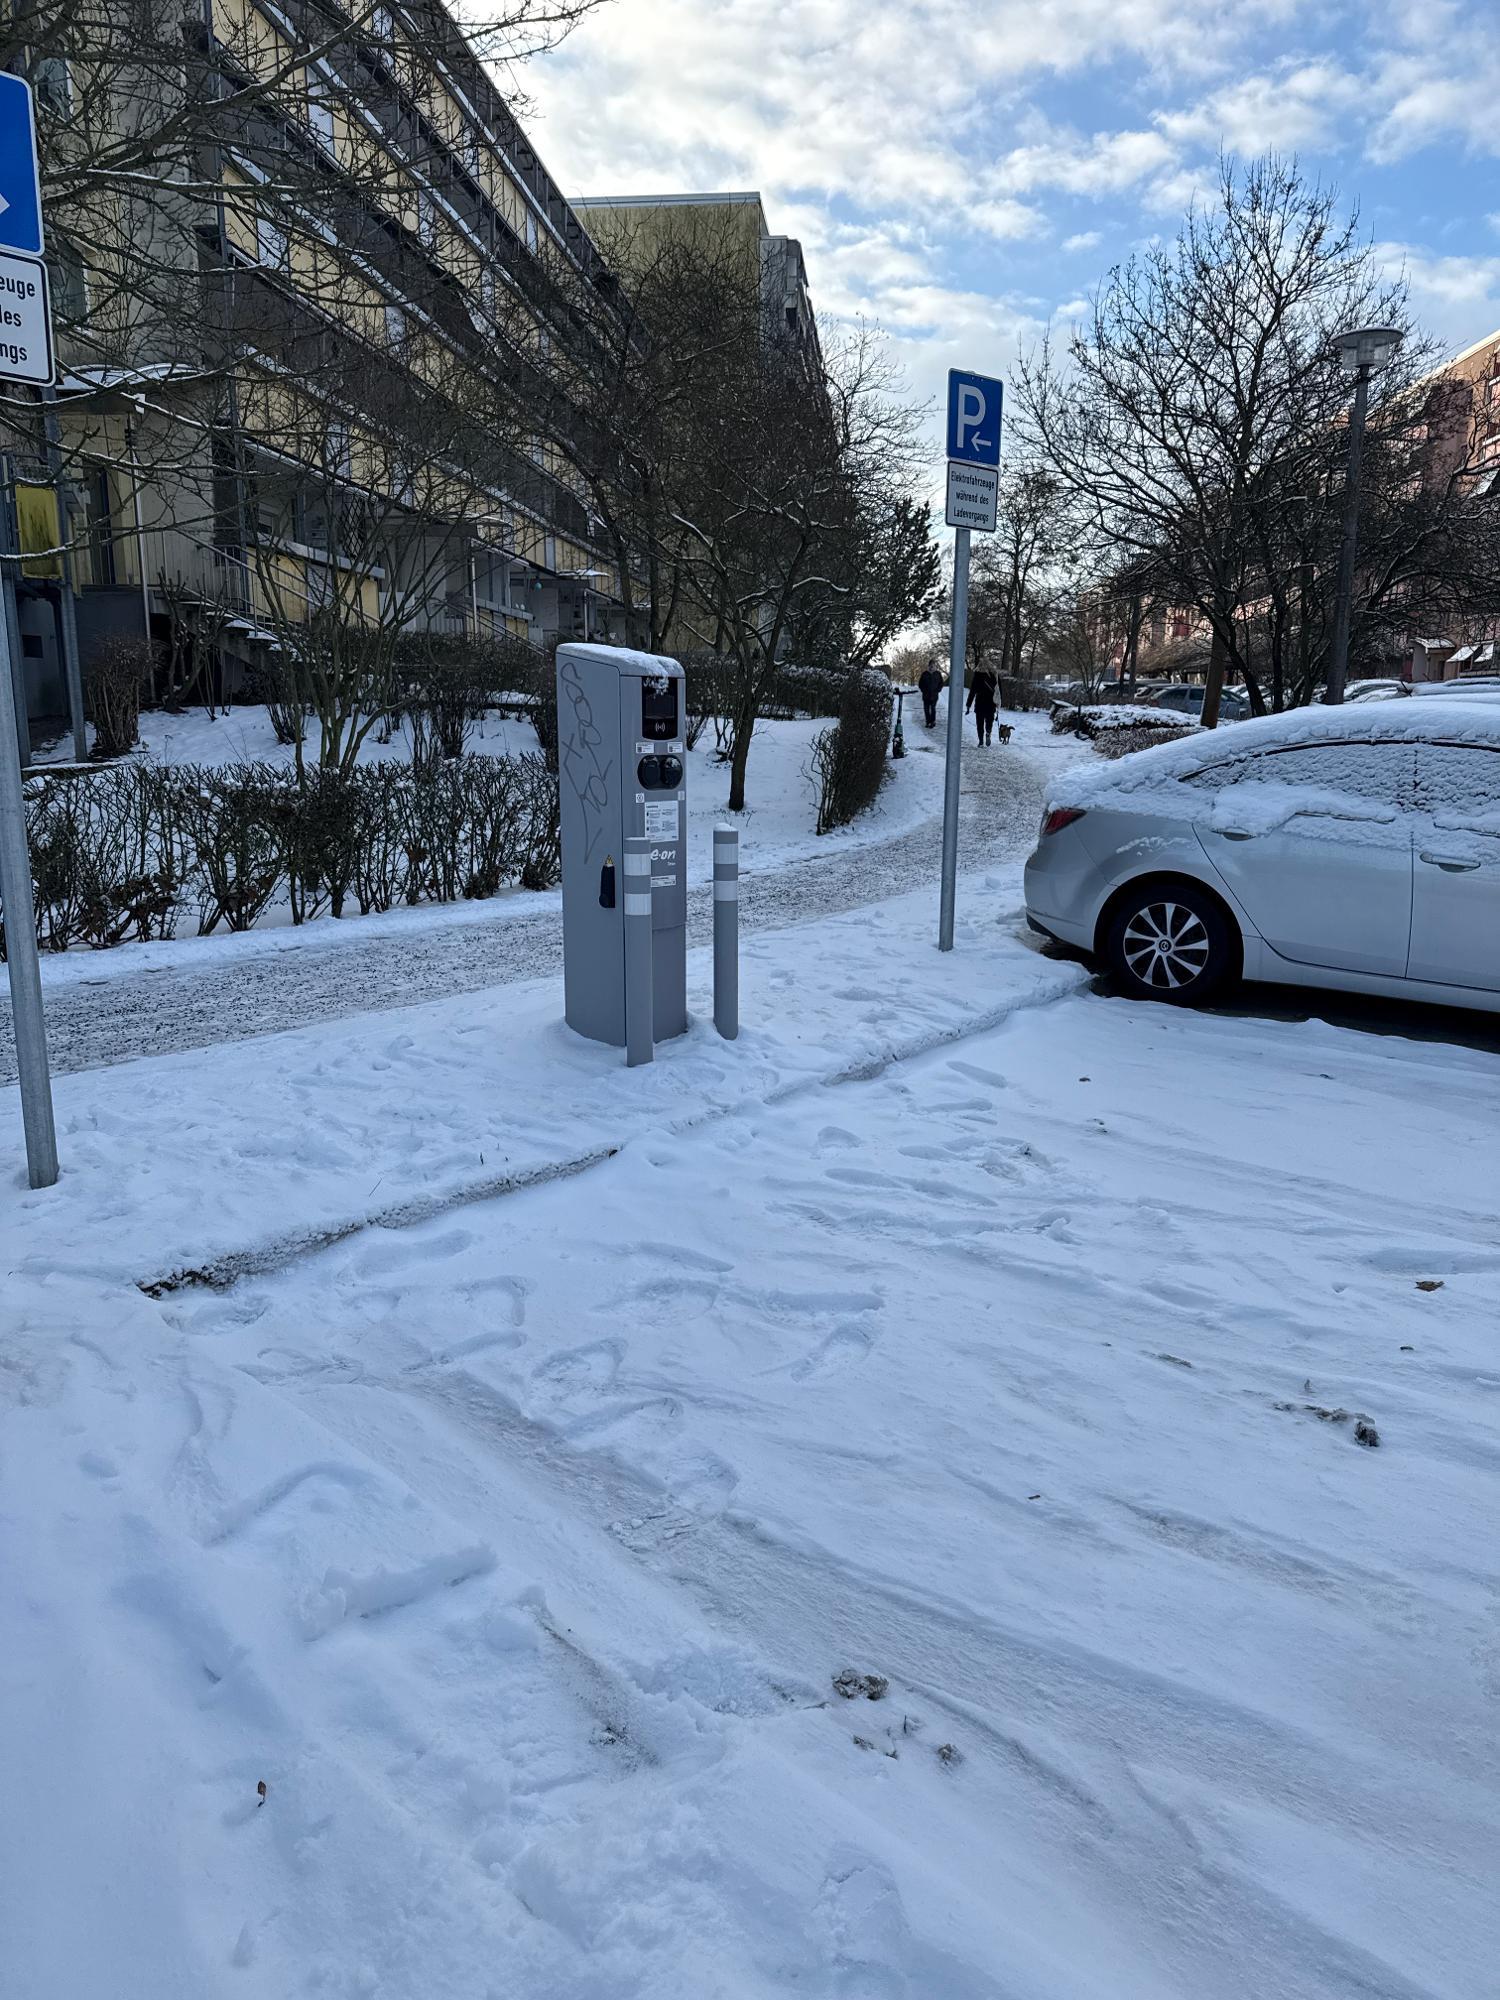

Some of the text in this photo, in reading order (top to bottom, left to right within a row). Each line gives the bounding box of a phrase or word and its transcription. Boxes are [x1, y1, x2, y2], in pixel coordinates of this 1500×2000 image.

[0, 304, 22, 327] es
[956, 383, 986, 448] P
[951, 470, 995, 491] Elektrofahrzeuge
[955, 490, 989, 505] während des
[953, 506, 989, 524] Ladevorgangs
